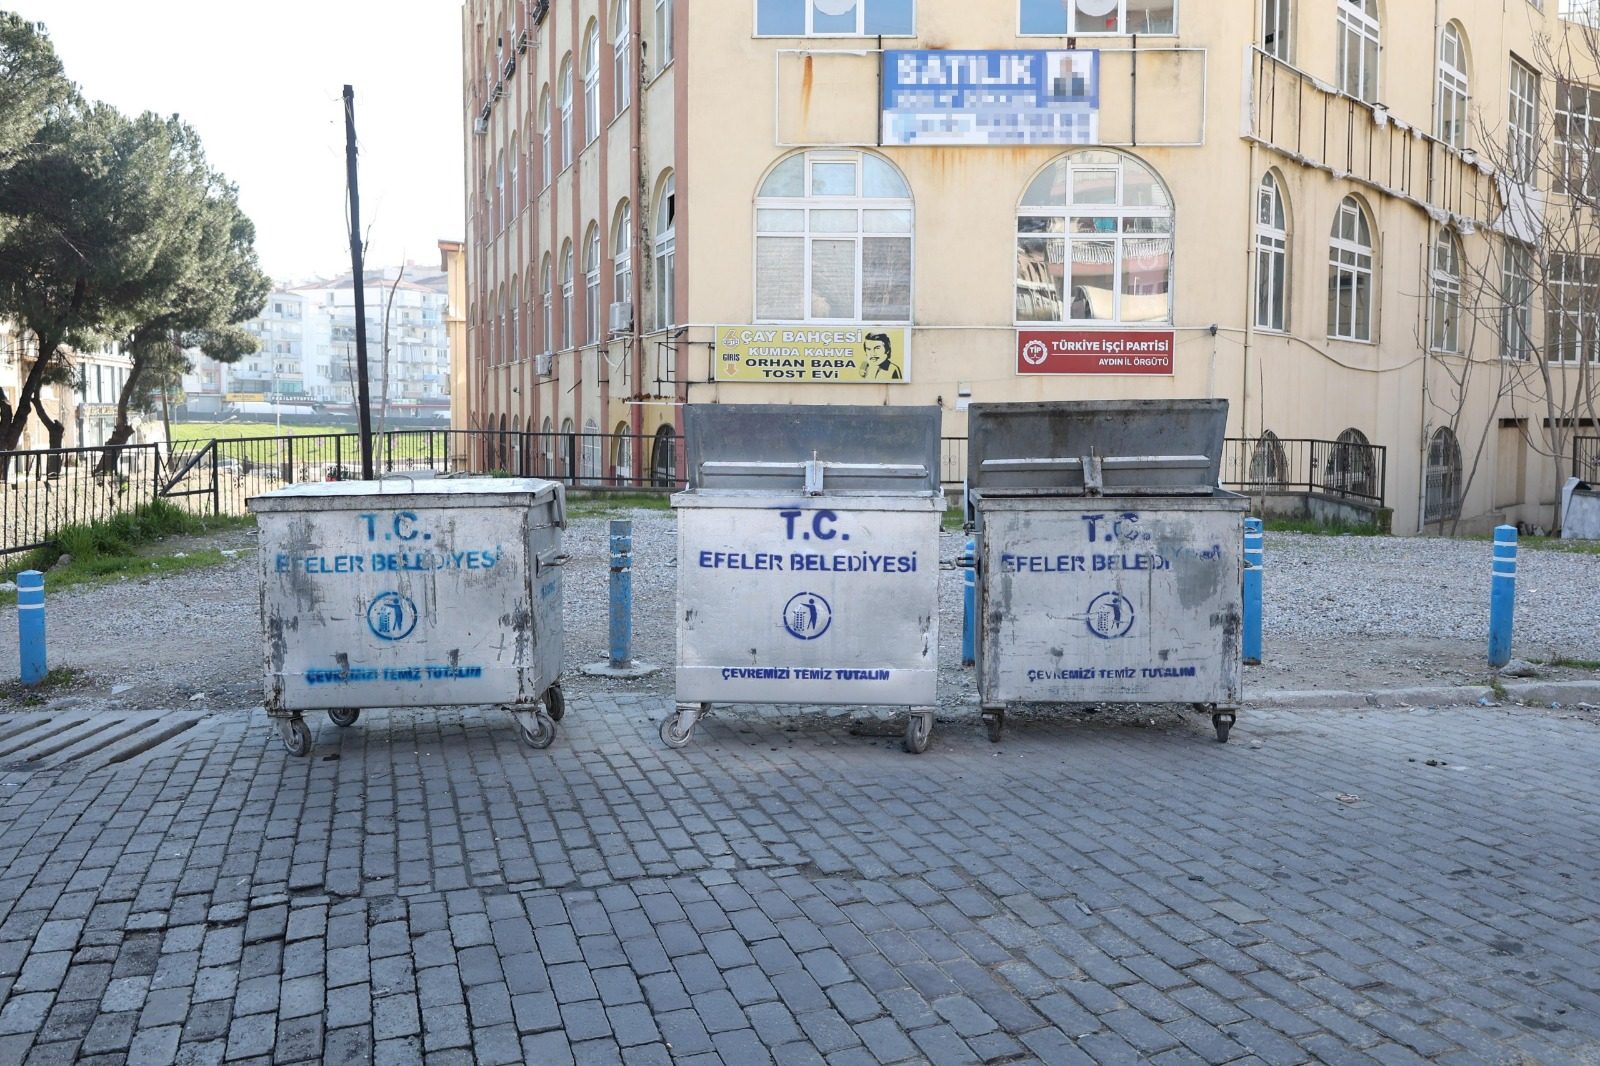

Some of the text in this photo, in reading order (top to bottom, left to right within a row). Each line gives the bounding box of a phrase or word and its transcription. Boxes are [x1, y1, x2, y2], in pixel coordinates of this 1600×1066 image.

[740, 330, 777, 345] ÇAY
[782, 328, 862, 346] BAHÇESİ
[748, 347, 854, 357] KUMDA KAHVE
[1052, 339, 1169, 353] TÜRKİYE İŞÇİ PARTİSİ
[745, 358, 856, 368] ORHAN BABA
[1098, 358, 1124, 366] AYDIN
[1133, 356, 1169, 366] ÖRGÜTÜ
[762, 369, 806, 379] TOST
[360, 512, 432, 542] T.C.
[780, 510, 850, 541] T.C.
[1081, 512, 1151, 542] T.C.
[275, 554, 365, 573] EELER
[699, 551, 917, 572] EFELER BELEDİYESİ
[1001, 554, 1085, 572] EFELER
[721, 666, 890, 681] ÇEVREMİZİ TEMİZ TUTALIM
[1099, 667, 1136, 679] TEMİZ
[1142, 666, 1196, 679] TUTALIM
